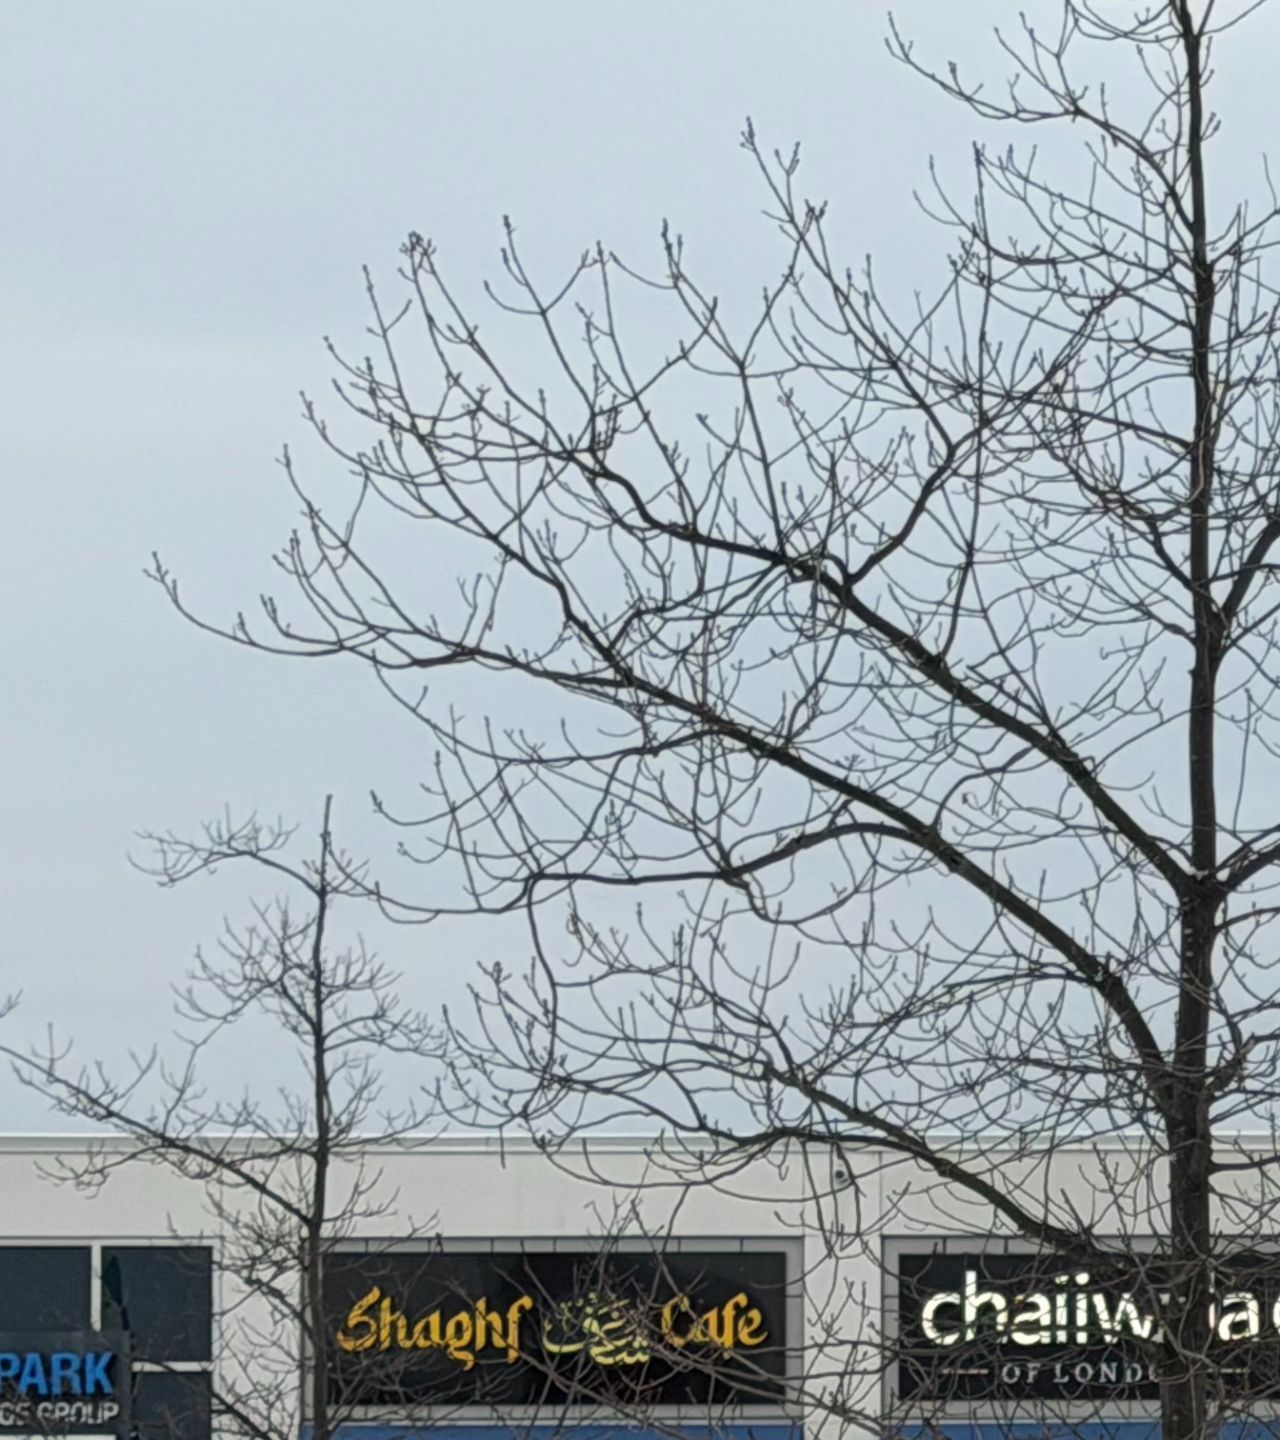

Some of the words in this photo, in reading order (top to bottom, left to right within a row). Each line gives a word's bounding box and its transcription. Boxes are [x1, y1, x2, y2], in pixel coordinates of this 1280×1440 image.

[337, 1286, 533, 1371] Shaghf
[661, 1292, 769, 1358] Cafe
[921, 1270, 1260, 1346] chaiiwa
[0, 1351, 113, 1395] PARK
[1002, 1363, 1043, 1384] OF
[1053, 1363, 1160, 1384] LONDO
[36, 1401, 120, 1425] GROUP
